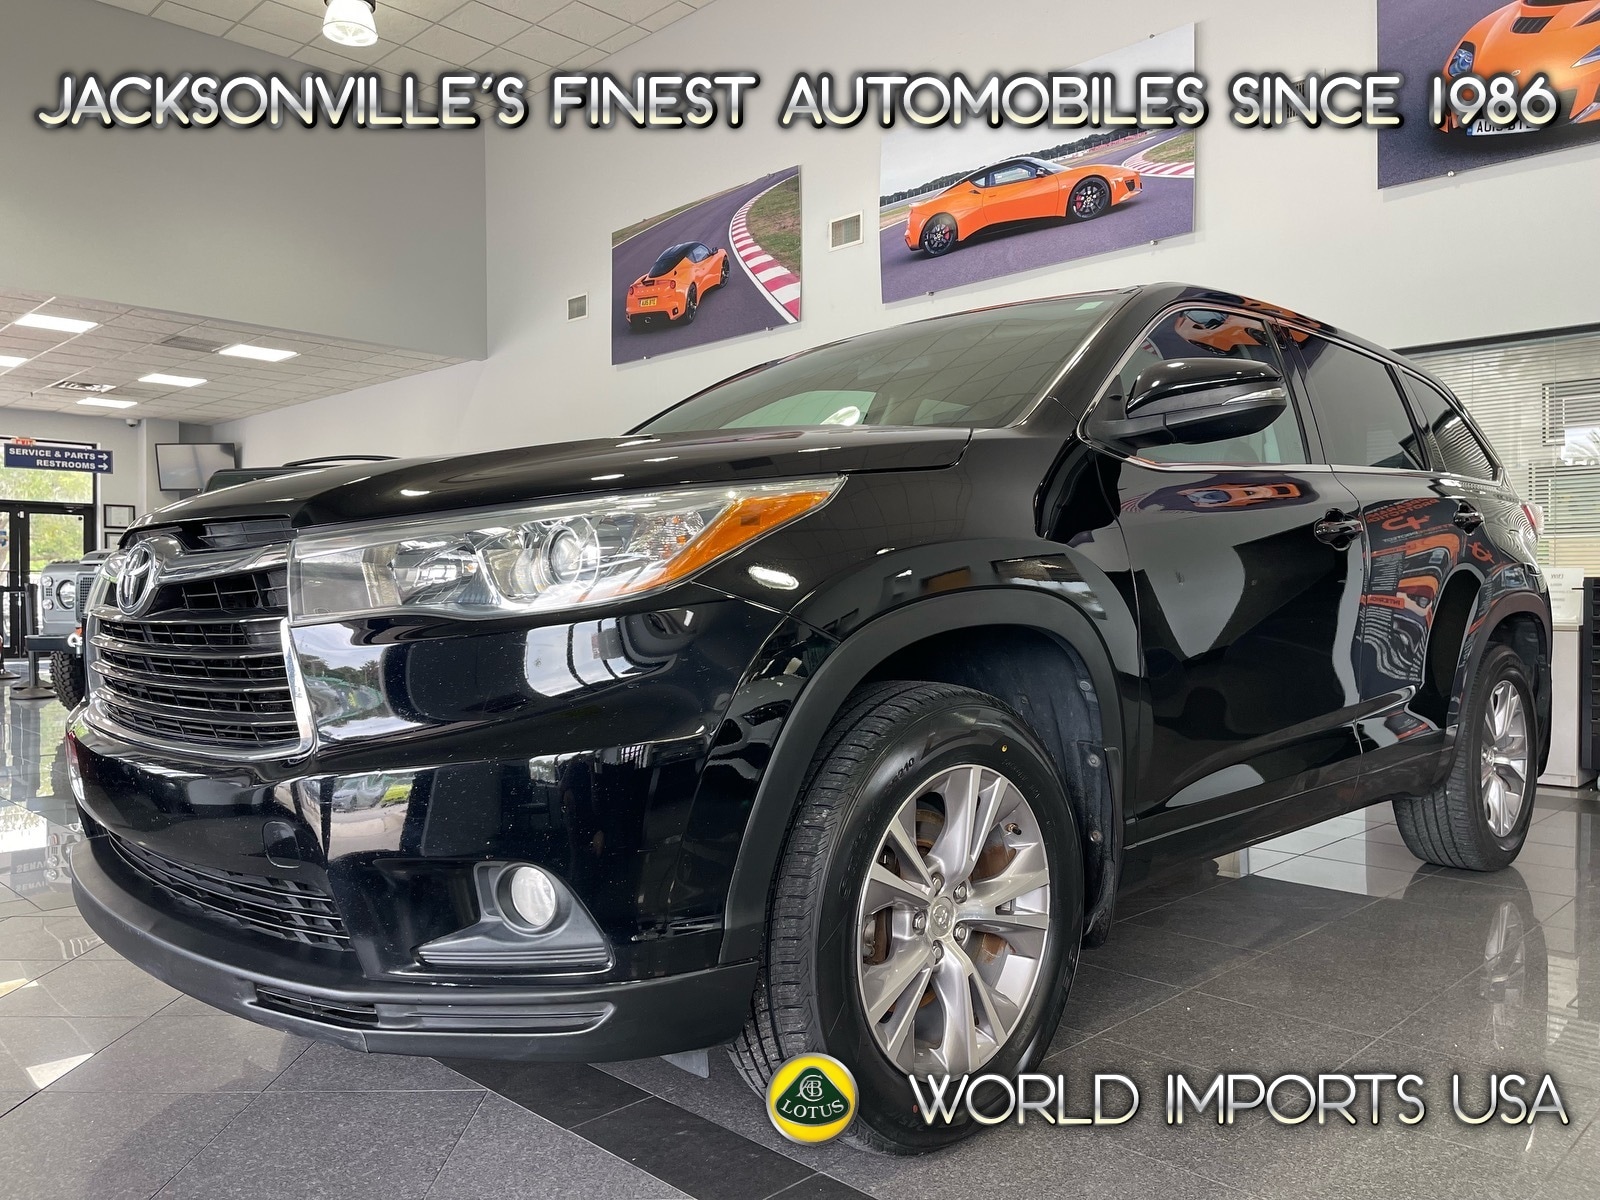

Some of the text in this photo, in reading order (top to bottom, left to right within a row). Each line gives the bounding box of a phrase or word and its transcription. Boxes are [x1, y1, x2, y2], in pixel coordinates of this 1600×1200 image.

[8, 447, 96, 460] SERVICE & PARTS
[36, 459, 96, 470] RESTROOMS
